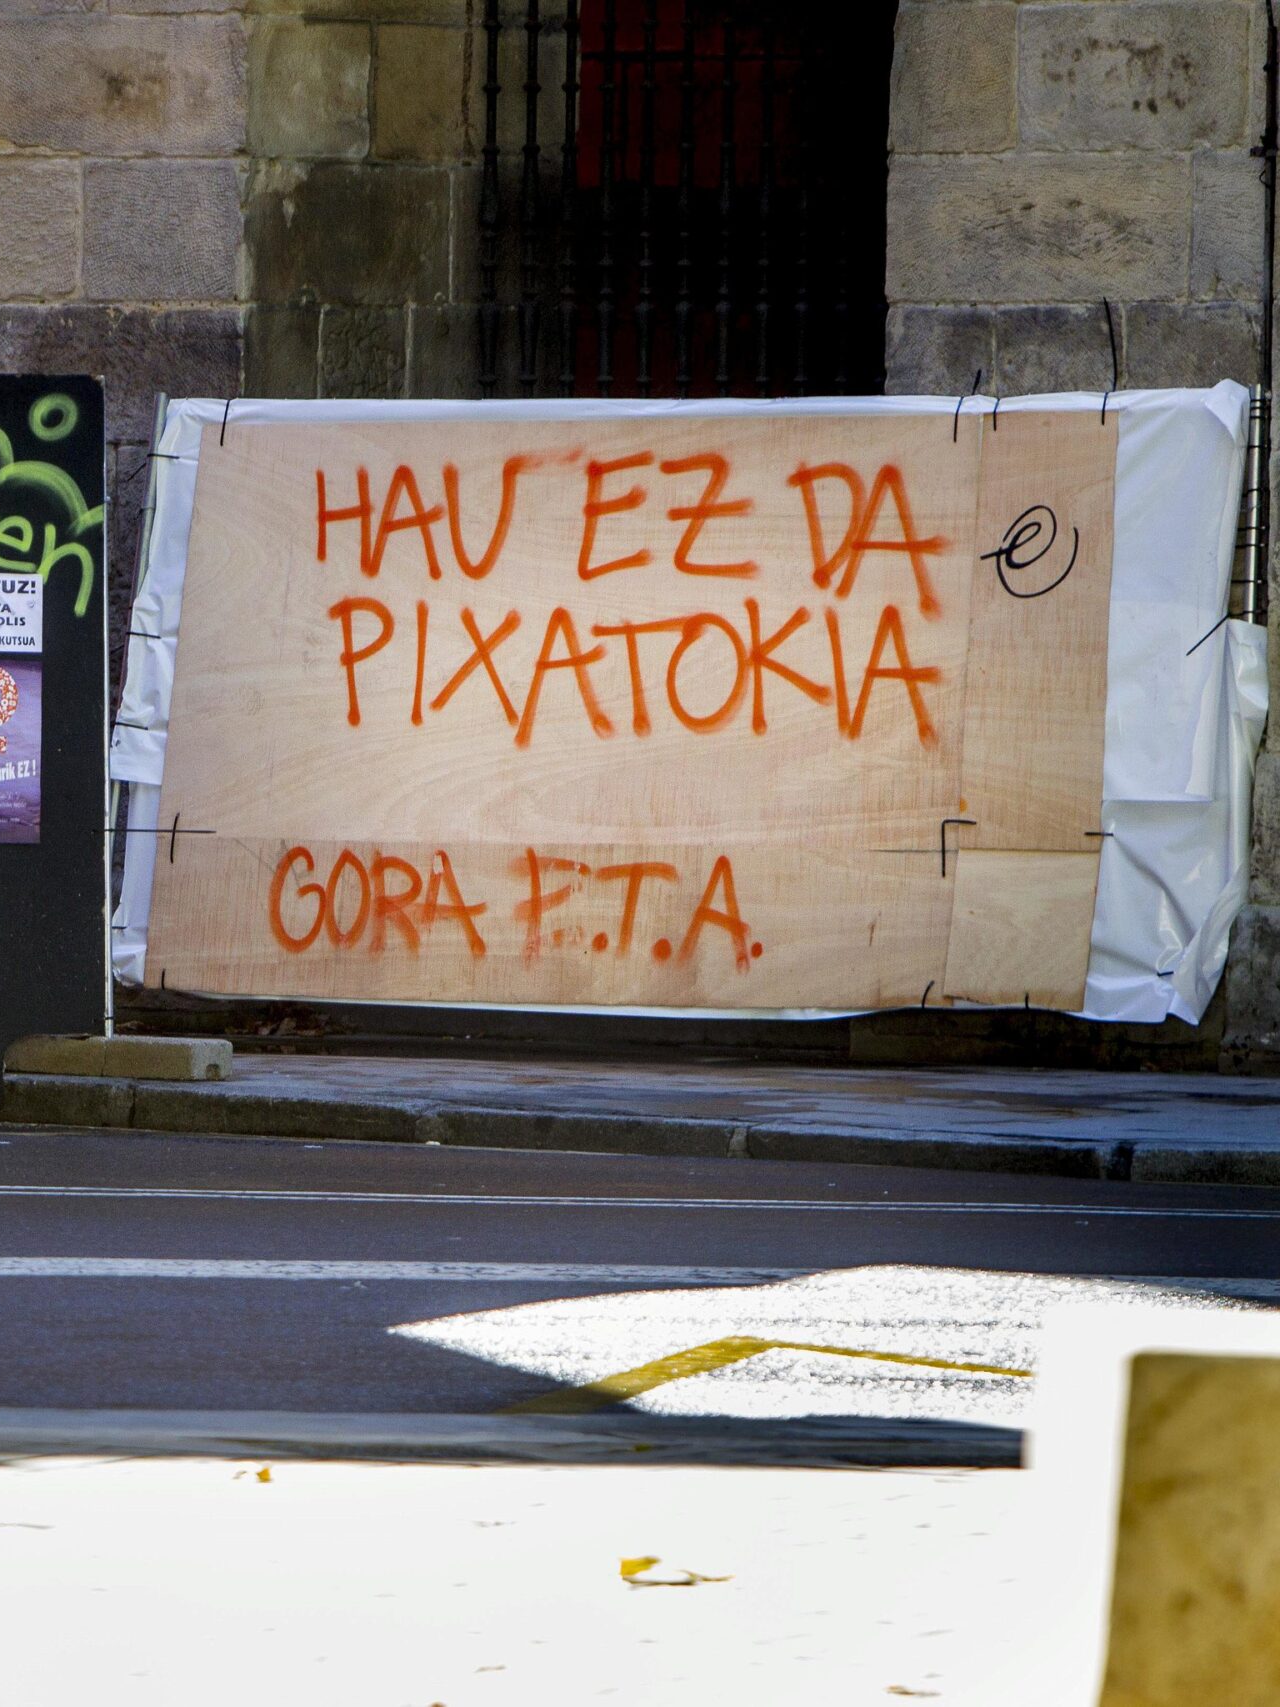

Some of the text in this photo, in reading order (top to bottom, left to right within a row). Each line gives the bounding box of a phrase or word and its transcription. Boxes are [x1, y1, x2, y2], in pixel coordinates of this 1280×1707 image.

[317, 452, 952, 620] HAU EZ DA
[327, 597, 944, 752] PIXATOKIA
[268, 845, 488, 960] GORA
